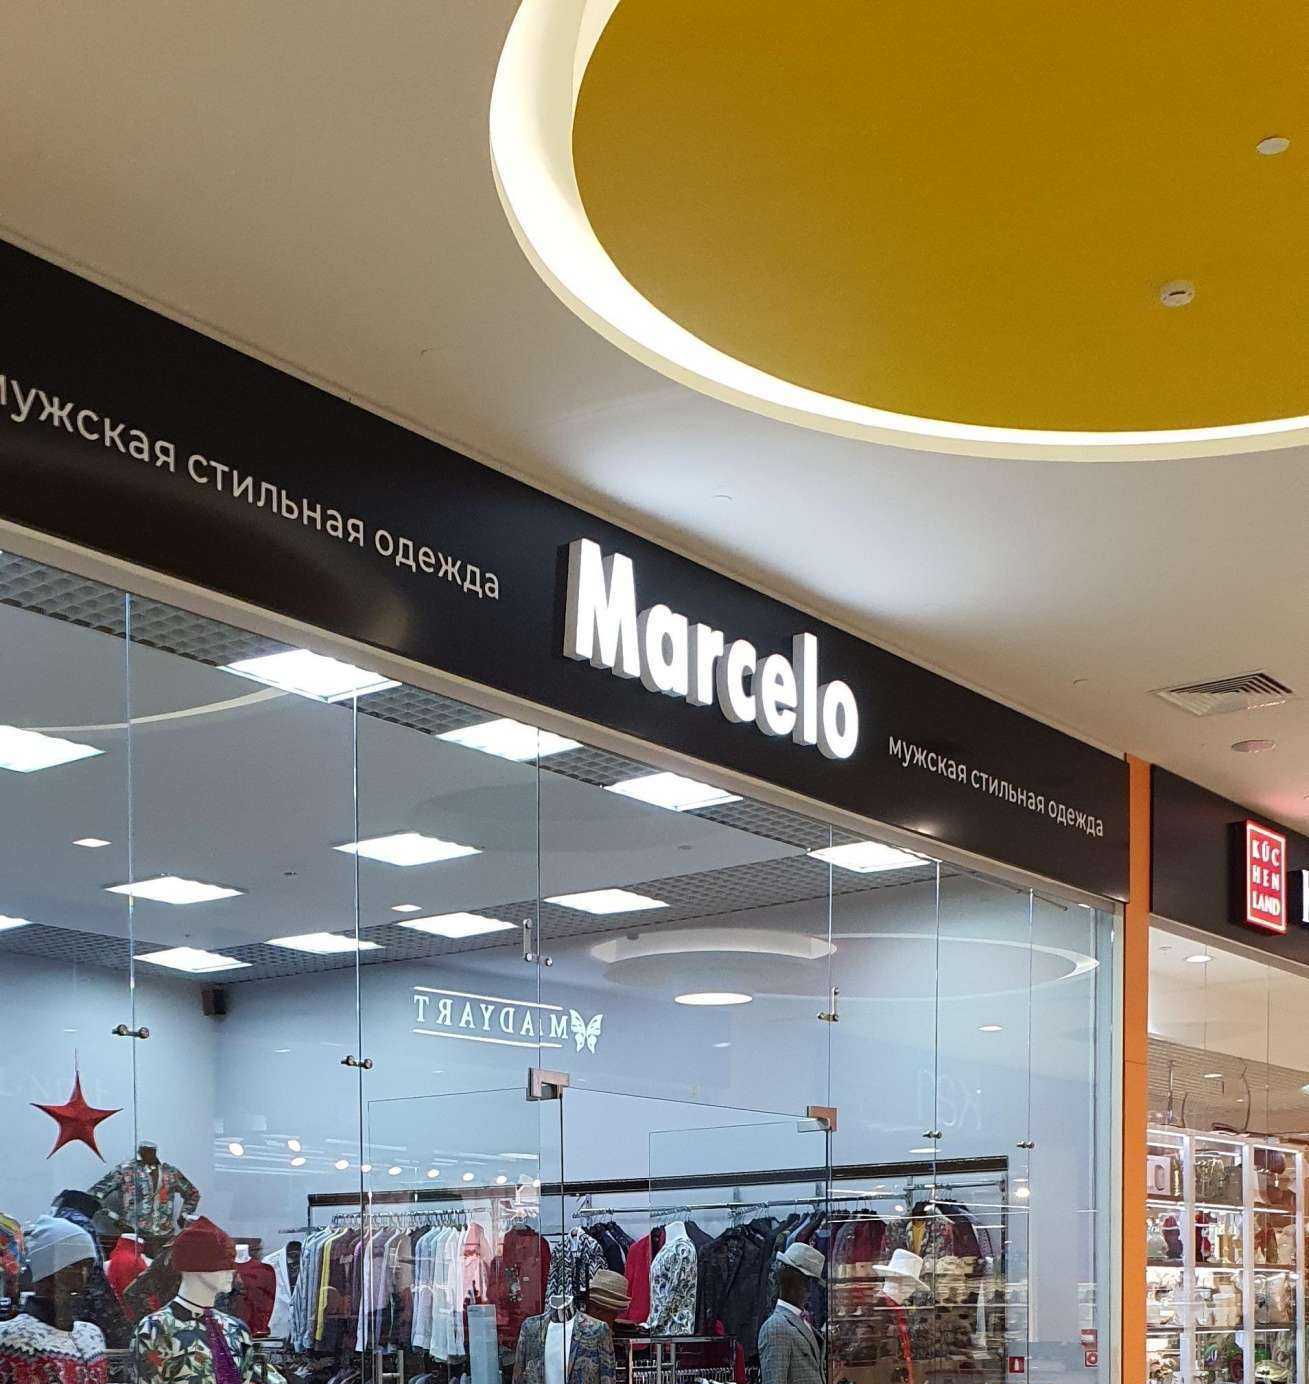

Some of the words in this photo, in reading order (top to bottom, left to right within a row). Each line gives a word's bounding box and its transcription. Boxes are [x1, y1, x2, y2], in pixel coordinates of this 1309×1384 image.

[187, 454, 364, 547] стильная
[374, 529, 500, 600] одежда
[563, 538, 859, 759] Marcelo
[889, 736, 967, 784] мужская
[970, 769, 1046, 814] стильная
[1048, 800, 1104, 837] одежда
[1252, 864, 1281, 891] HEN
[1252, 890, 1281, 916] LAND
